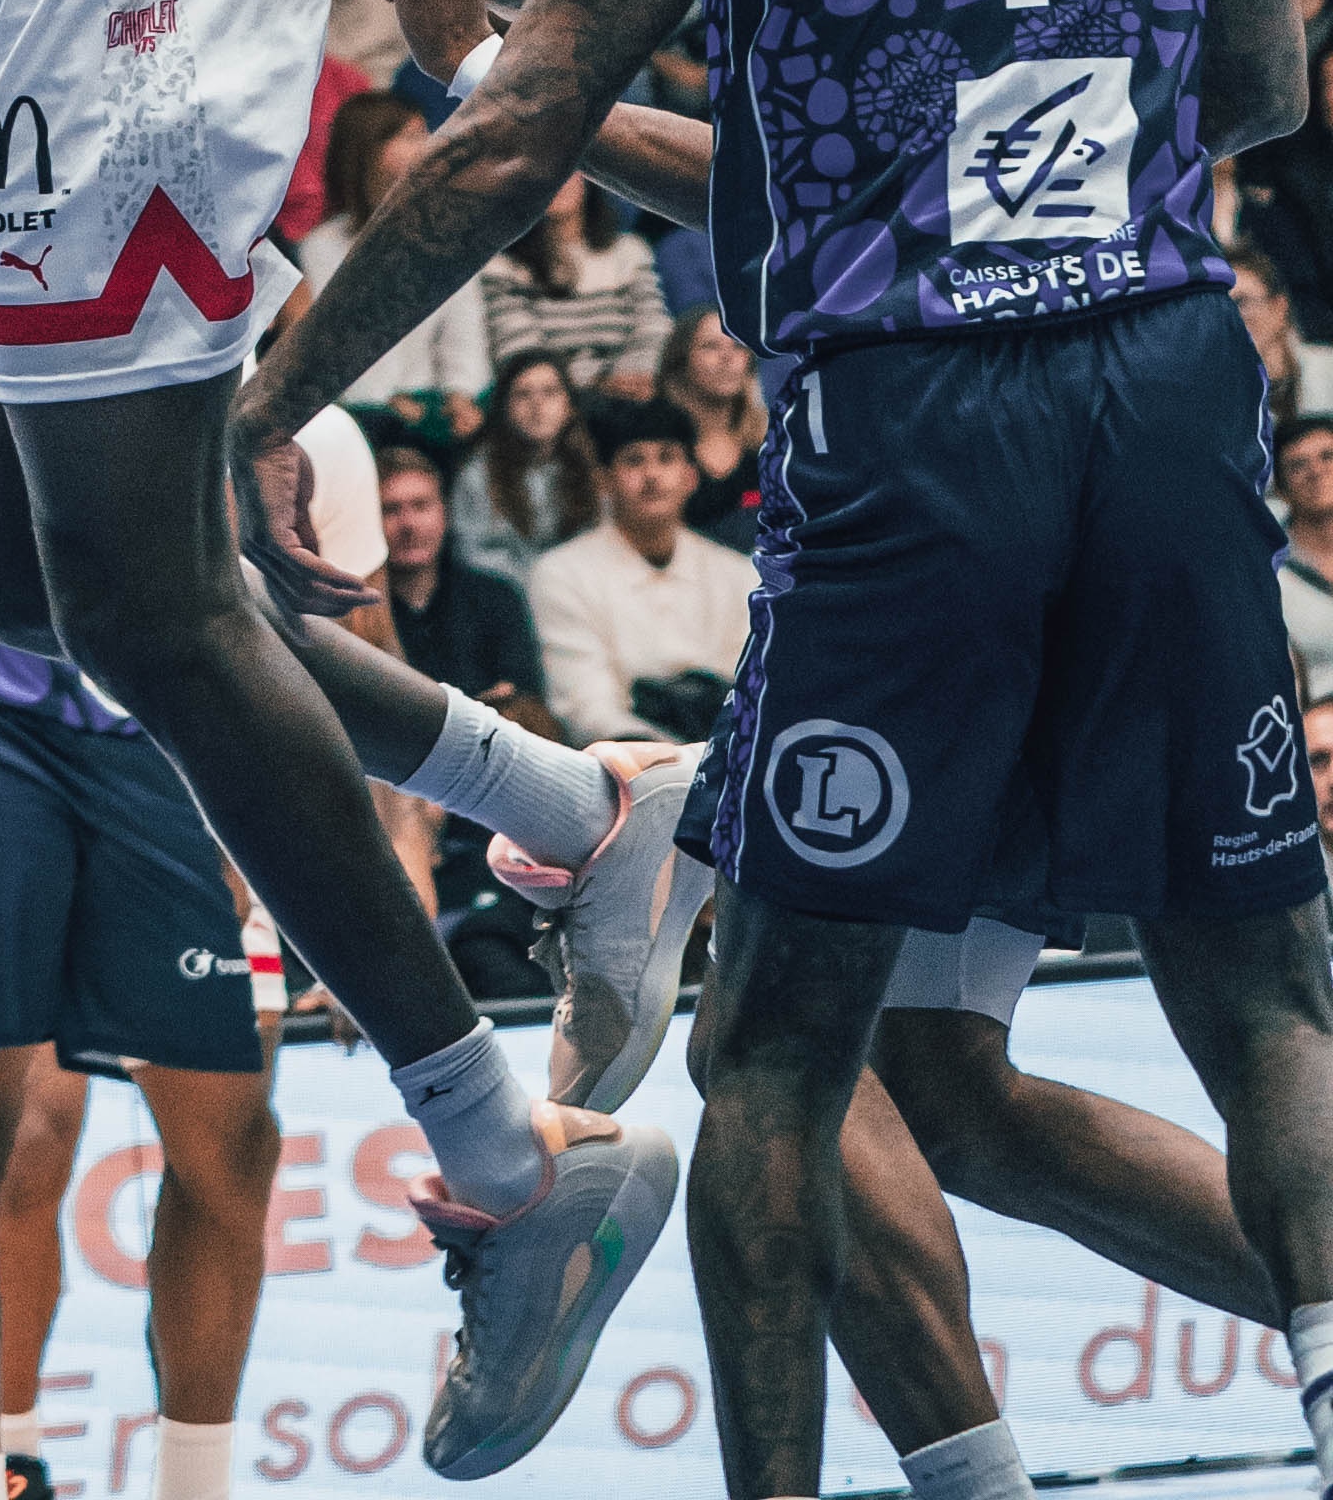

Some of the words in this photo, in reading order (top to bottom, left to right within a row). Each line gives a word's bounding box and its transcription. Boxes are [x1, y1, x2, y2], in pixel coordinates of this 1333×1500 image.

[949, 265, 1023, 286] CAISSE
[1095, 250, 1146, 281] DE
[801, 369, 830, 455] 1
[792, 753, 854, 839] L
